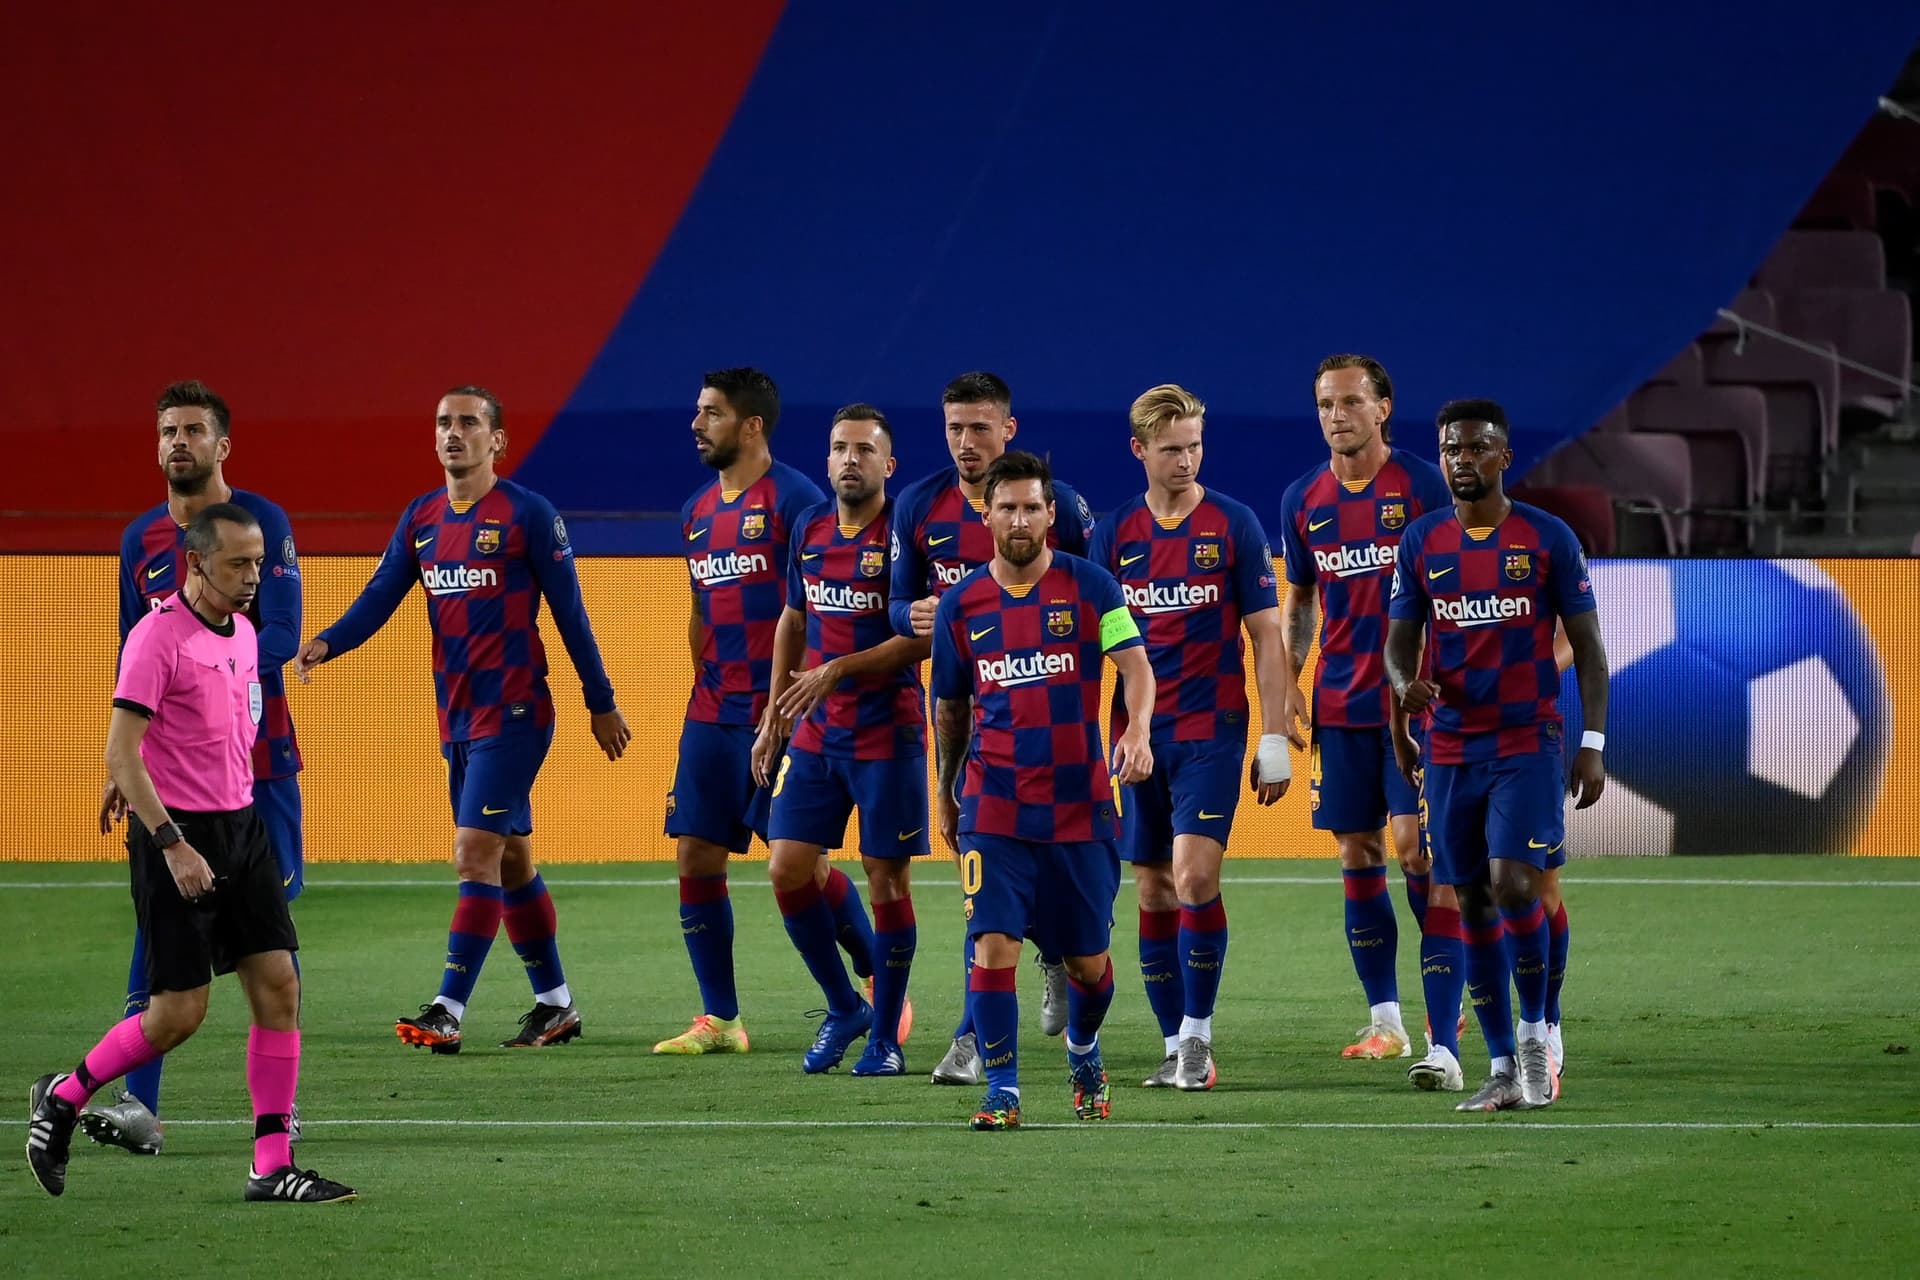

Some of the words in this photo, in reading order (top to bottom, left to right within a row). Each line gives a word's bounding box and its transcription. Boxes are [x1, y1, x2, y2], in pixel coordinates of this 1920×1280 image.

[421, 564, 497, 588] akuten
[689, 552, 768, 580] Rakuten
[1121, 582, 1218, 606] Rakuten
[1432, 595, 1531, 620] Rakuten
[977, 651, 1075, 682] Rakuten
[960, 849, 983, 896] 0
[985, 1050, 1014, 1068] BARÇA
